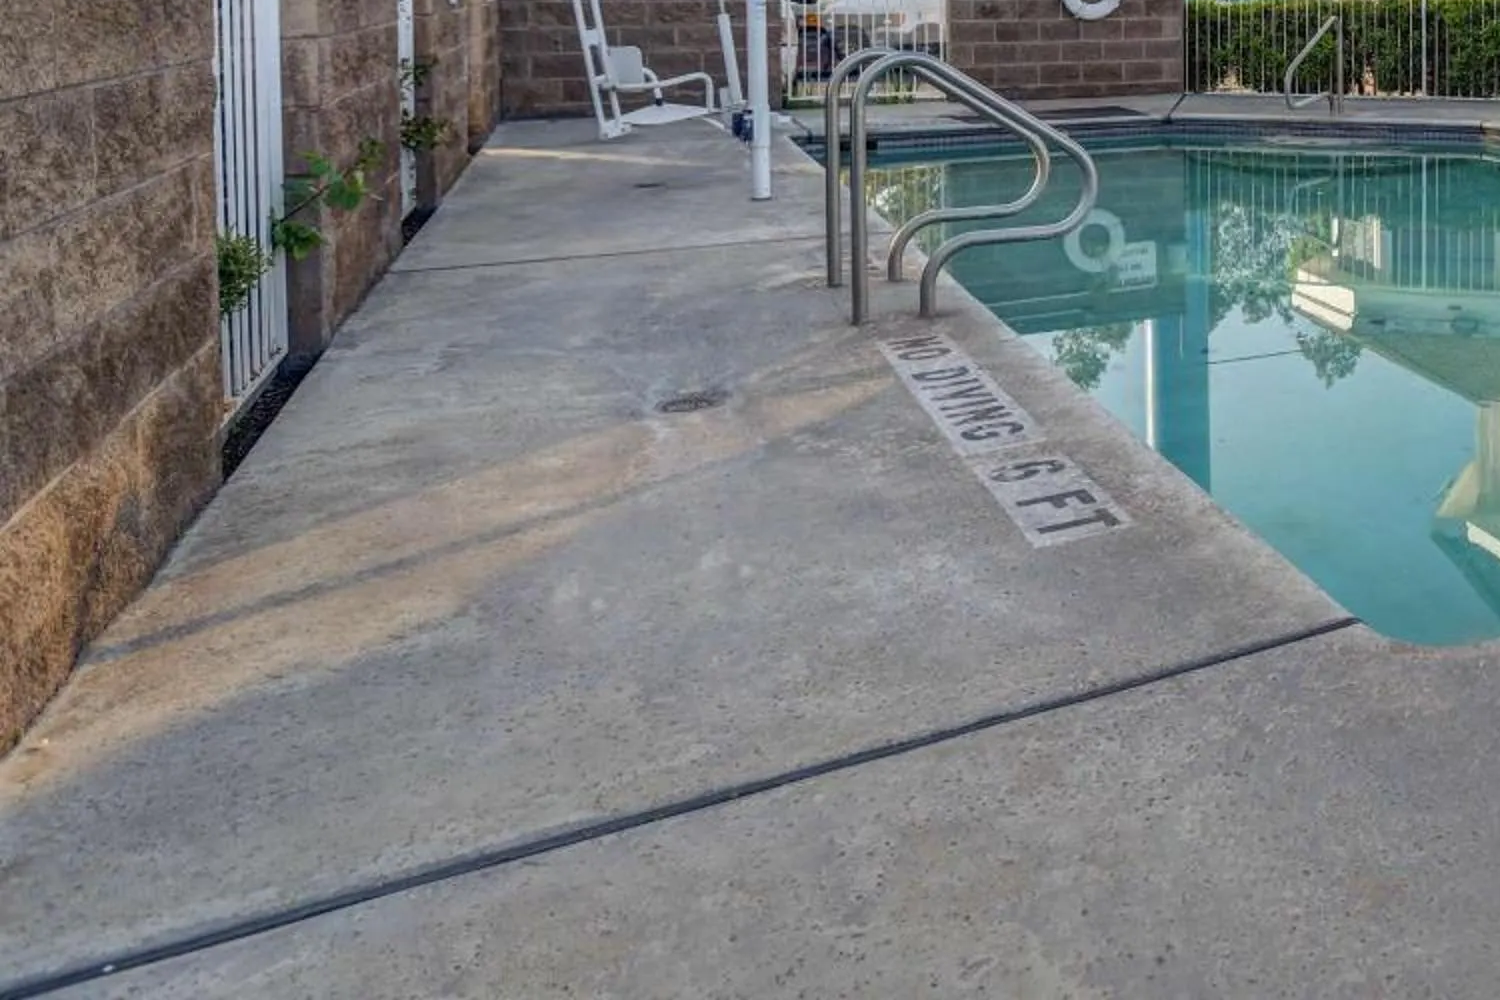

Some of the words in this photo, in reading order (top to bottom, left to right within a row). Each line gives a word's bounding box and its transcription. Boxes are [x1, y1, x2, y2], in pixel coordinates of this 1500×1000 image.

[885, 335, 952, 361] NO
[912, 366, 1025, 441] DIVING
[990, 459, 1066, 483] 6
[1016, 488, 1121, 534] FT
